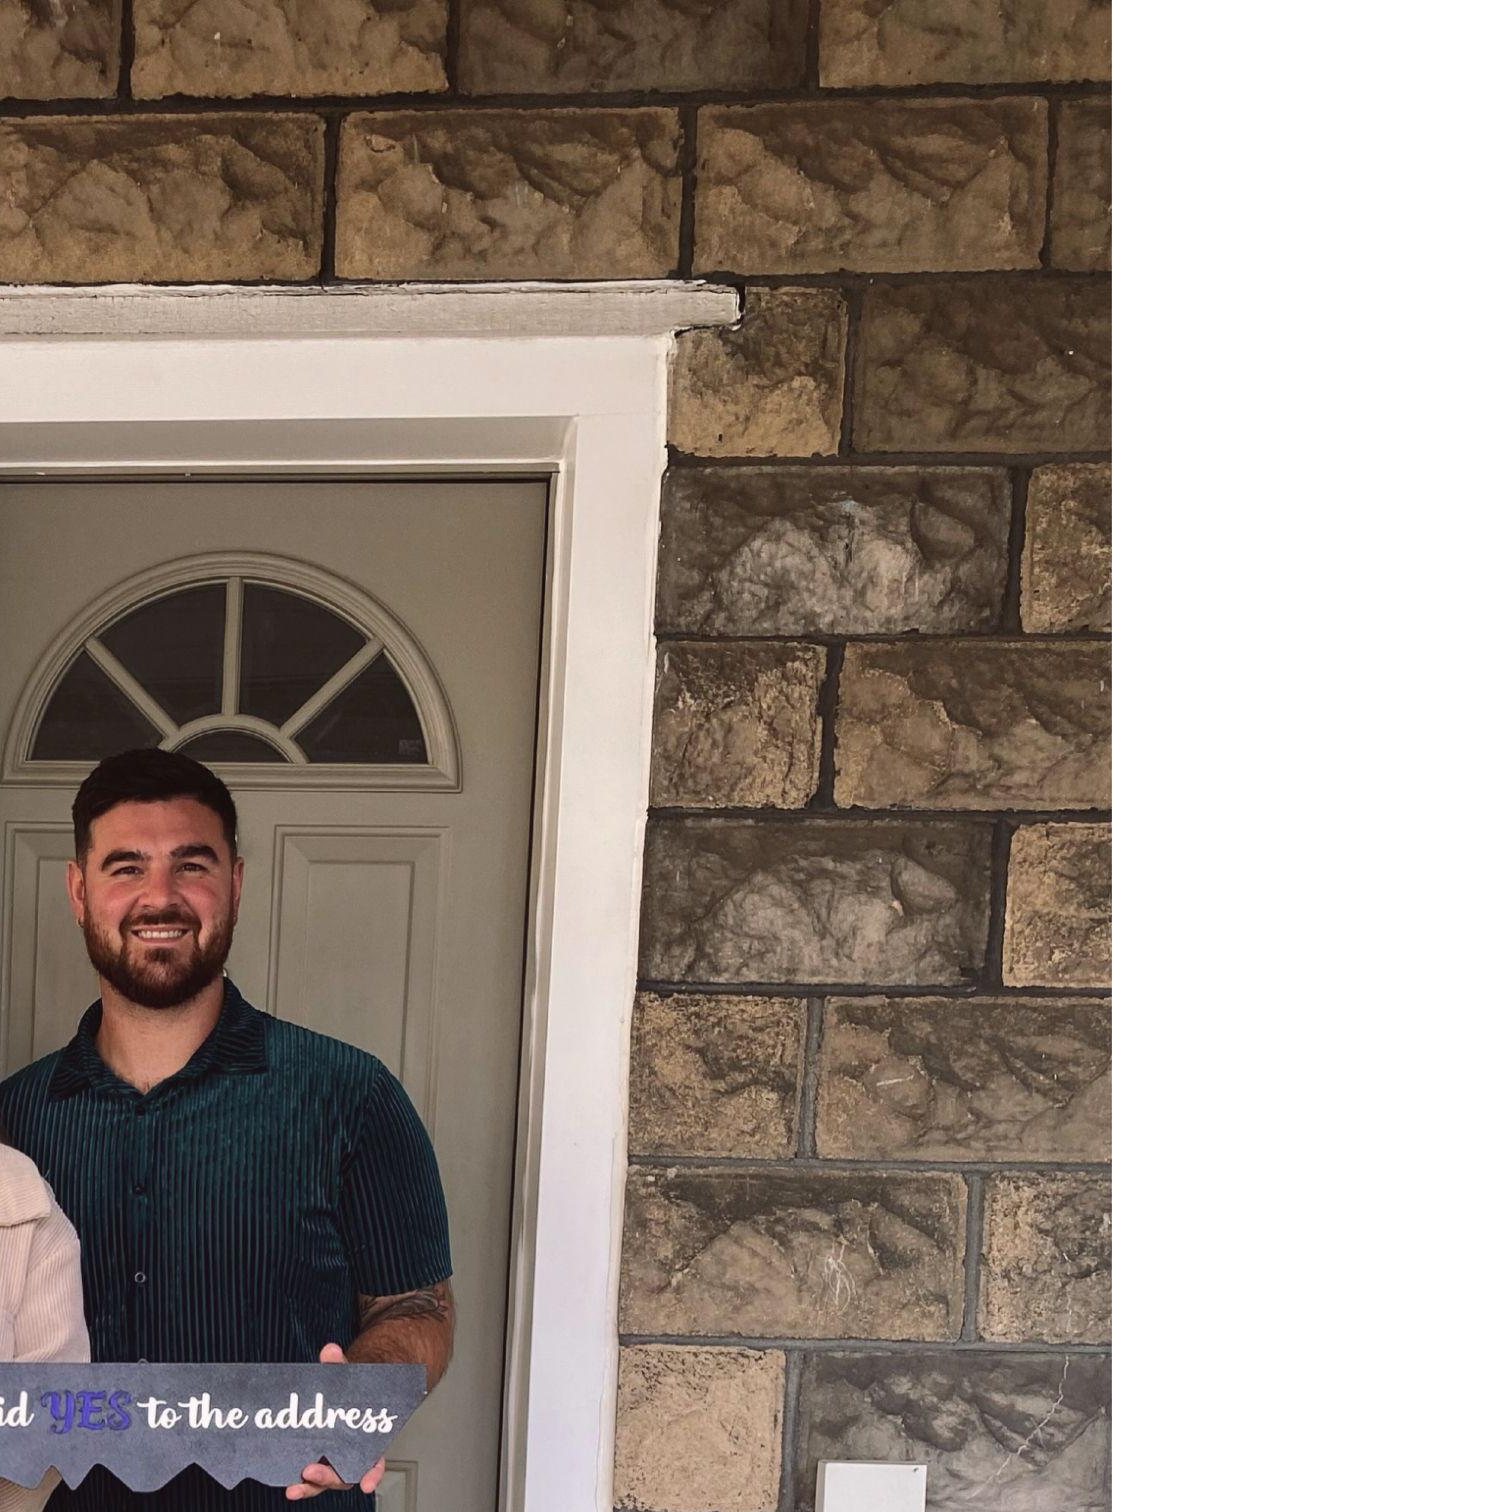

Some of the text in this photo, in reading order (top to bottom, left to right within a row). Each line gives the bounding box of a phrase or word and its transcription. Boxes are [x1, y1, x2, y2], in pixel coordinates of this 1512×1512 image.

[40, 1388, 134, 1434] YES
[137, 1396, 182, 1429] to
[178, 1391, 249, 1429] the
[254, 1391, 398, 1434] address
